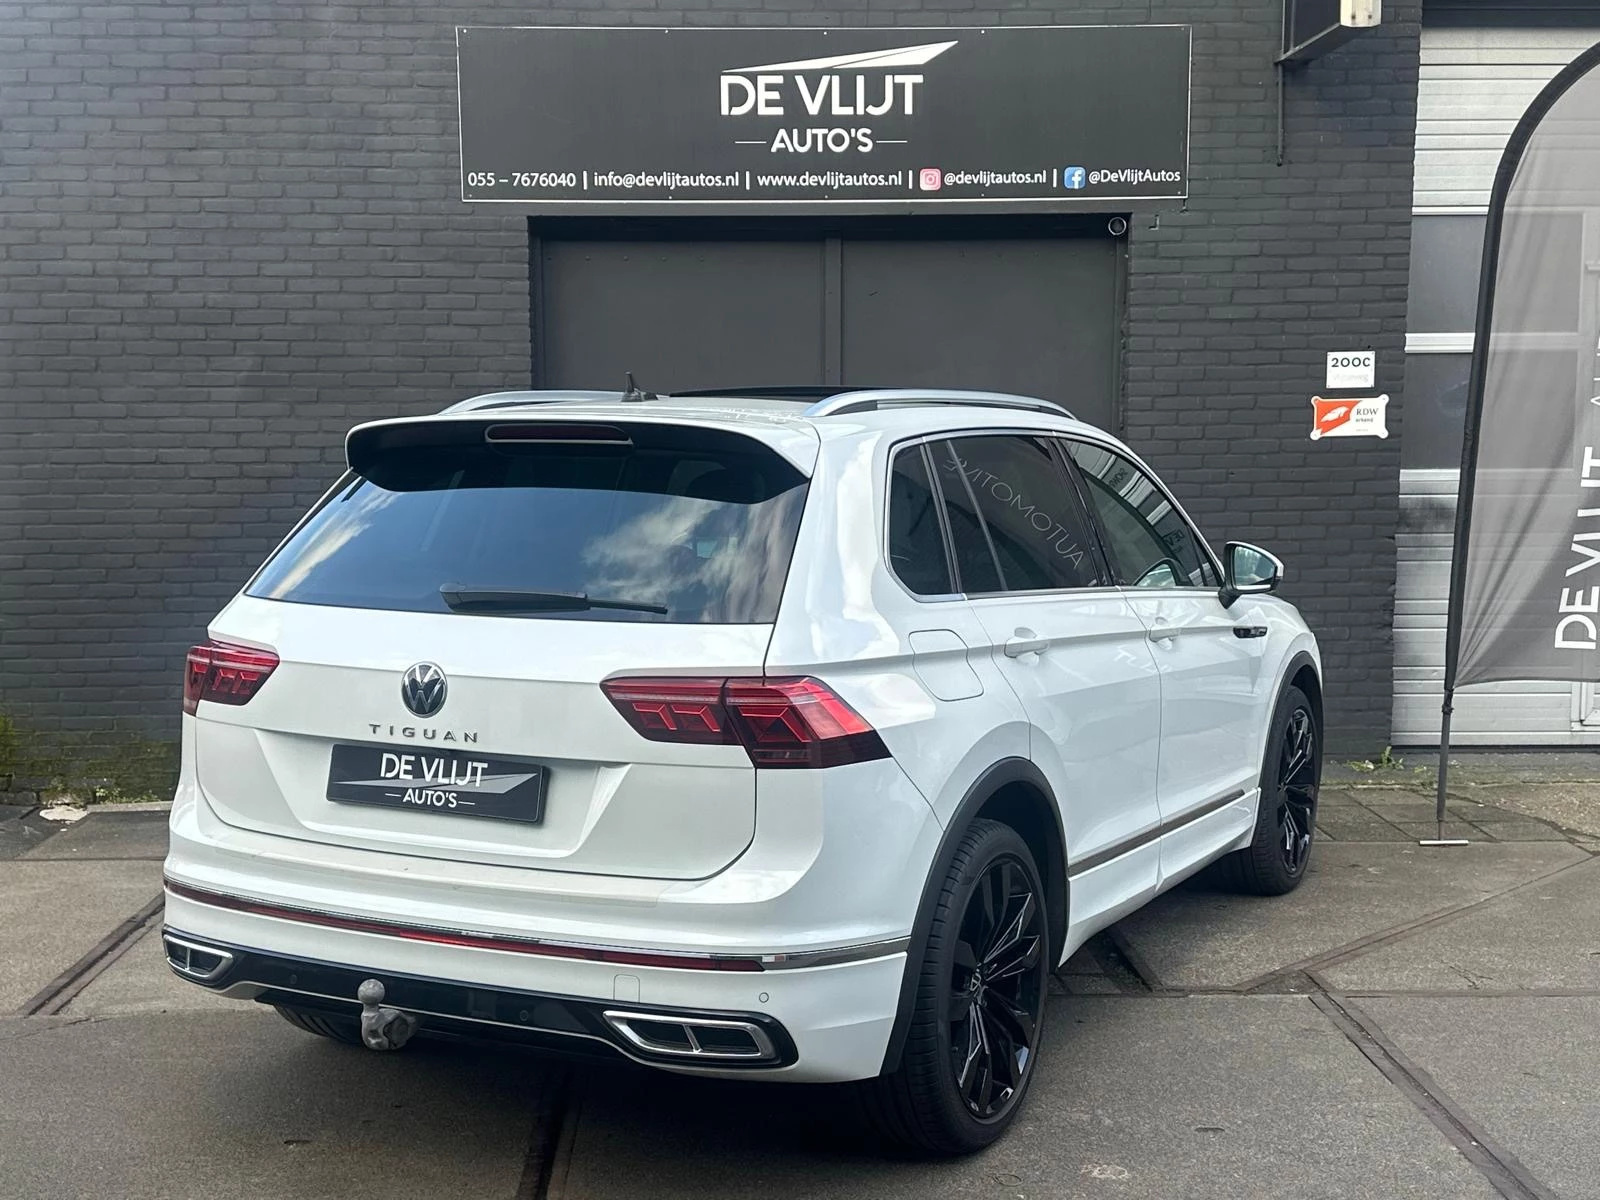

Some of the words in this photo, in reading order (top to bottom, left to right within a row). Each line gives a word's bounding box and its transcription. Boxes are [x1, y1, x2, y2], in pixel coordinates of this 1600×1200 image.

[720, 74, 785, 116] DE
[794, 74, 924, 116] VLIJT
[770, 127, 874, 154] AUTO'S
[467, 172, 496, 187] 055
[511, 172, 577, 188] 7676040
[593, 170, 740, 190] info@devlijtautos.nl
[756, 170, 903, 190] www.devlijtautos.nl
[943, 169, 1047, 188] @devlijtautos.nl
[1088, 168, 1181, 186] @DeVlijtAutos
[1356, 408, 1379, 416] RDW
[1555, 585, 1600, 650] DE
[368, 723, 478, 743] TIGUAN
[380, 753, 416, 780] DE
[420, 756, 488, 787] VLIJT
[402, 788, 458, 808] AUTO'S
